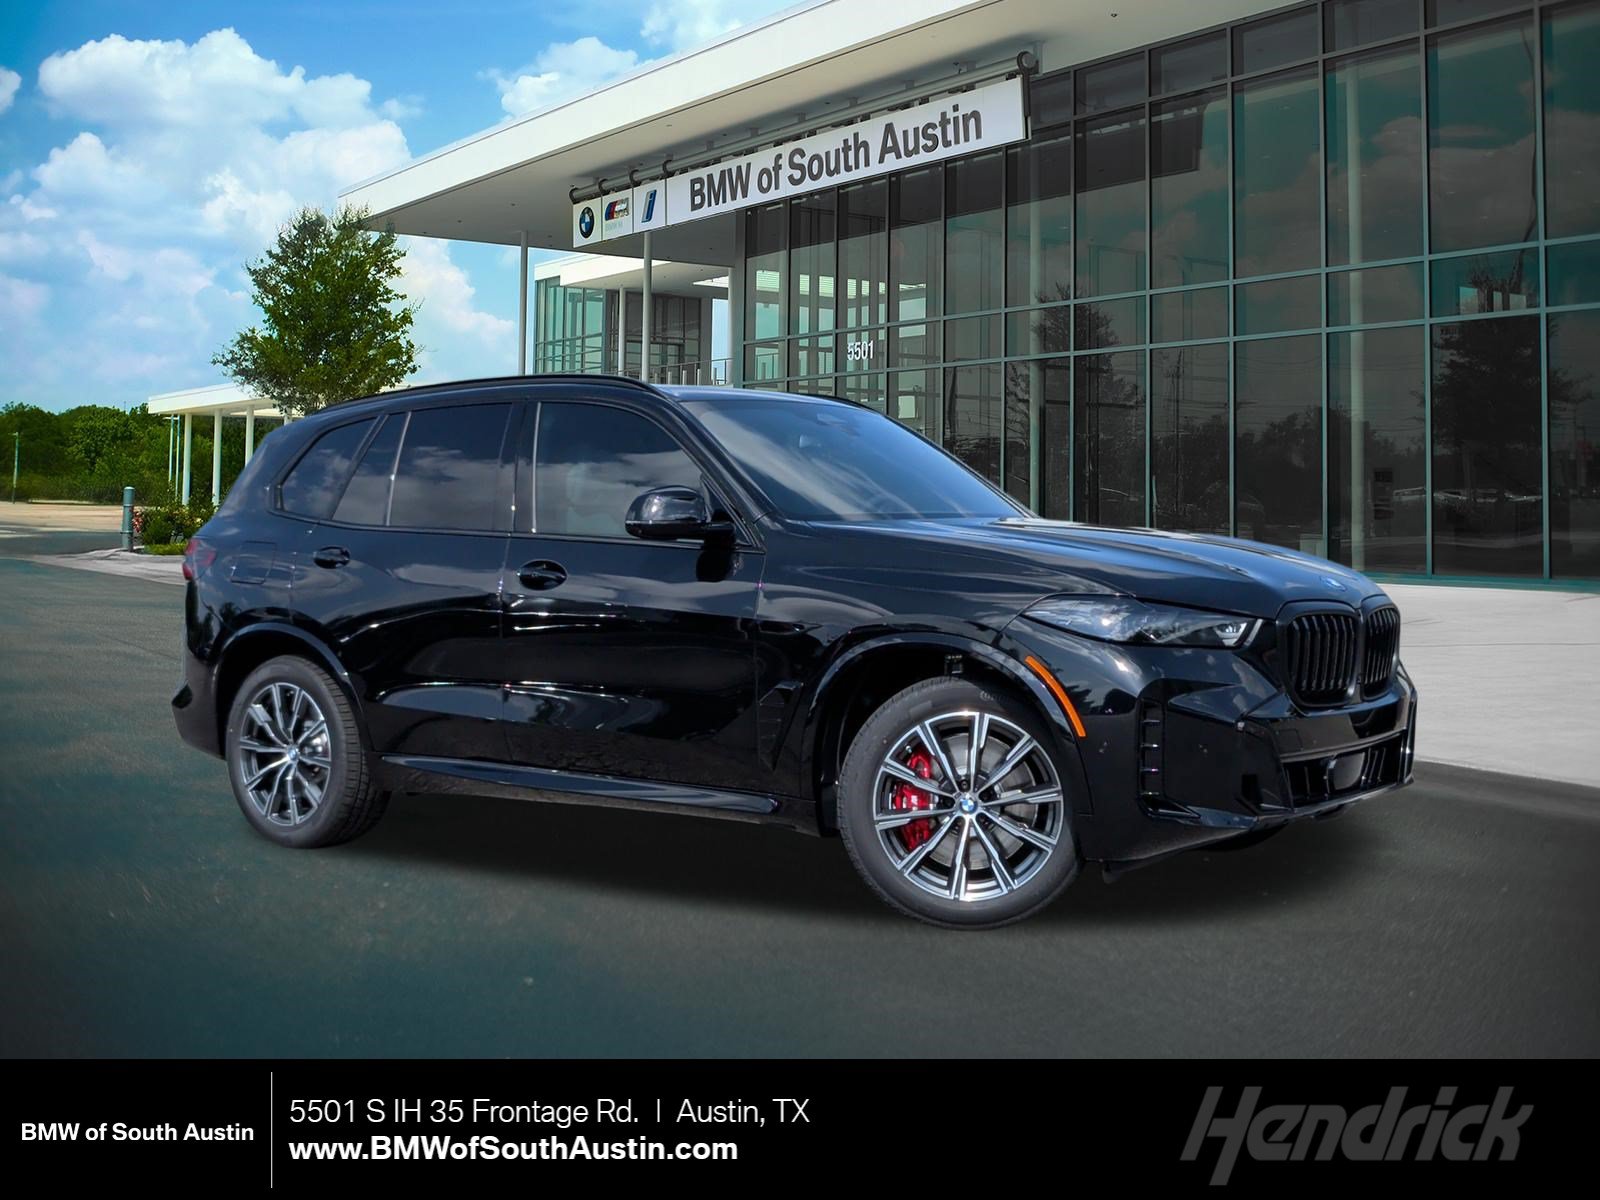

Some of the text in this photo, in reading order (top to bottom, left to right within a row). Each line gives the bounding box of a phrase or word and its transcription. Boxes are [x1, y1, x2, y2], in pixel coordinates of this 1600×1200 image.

[690, 104, 982, 211] BMW of South Austin
[847, 340, 873, 360] 5501
